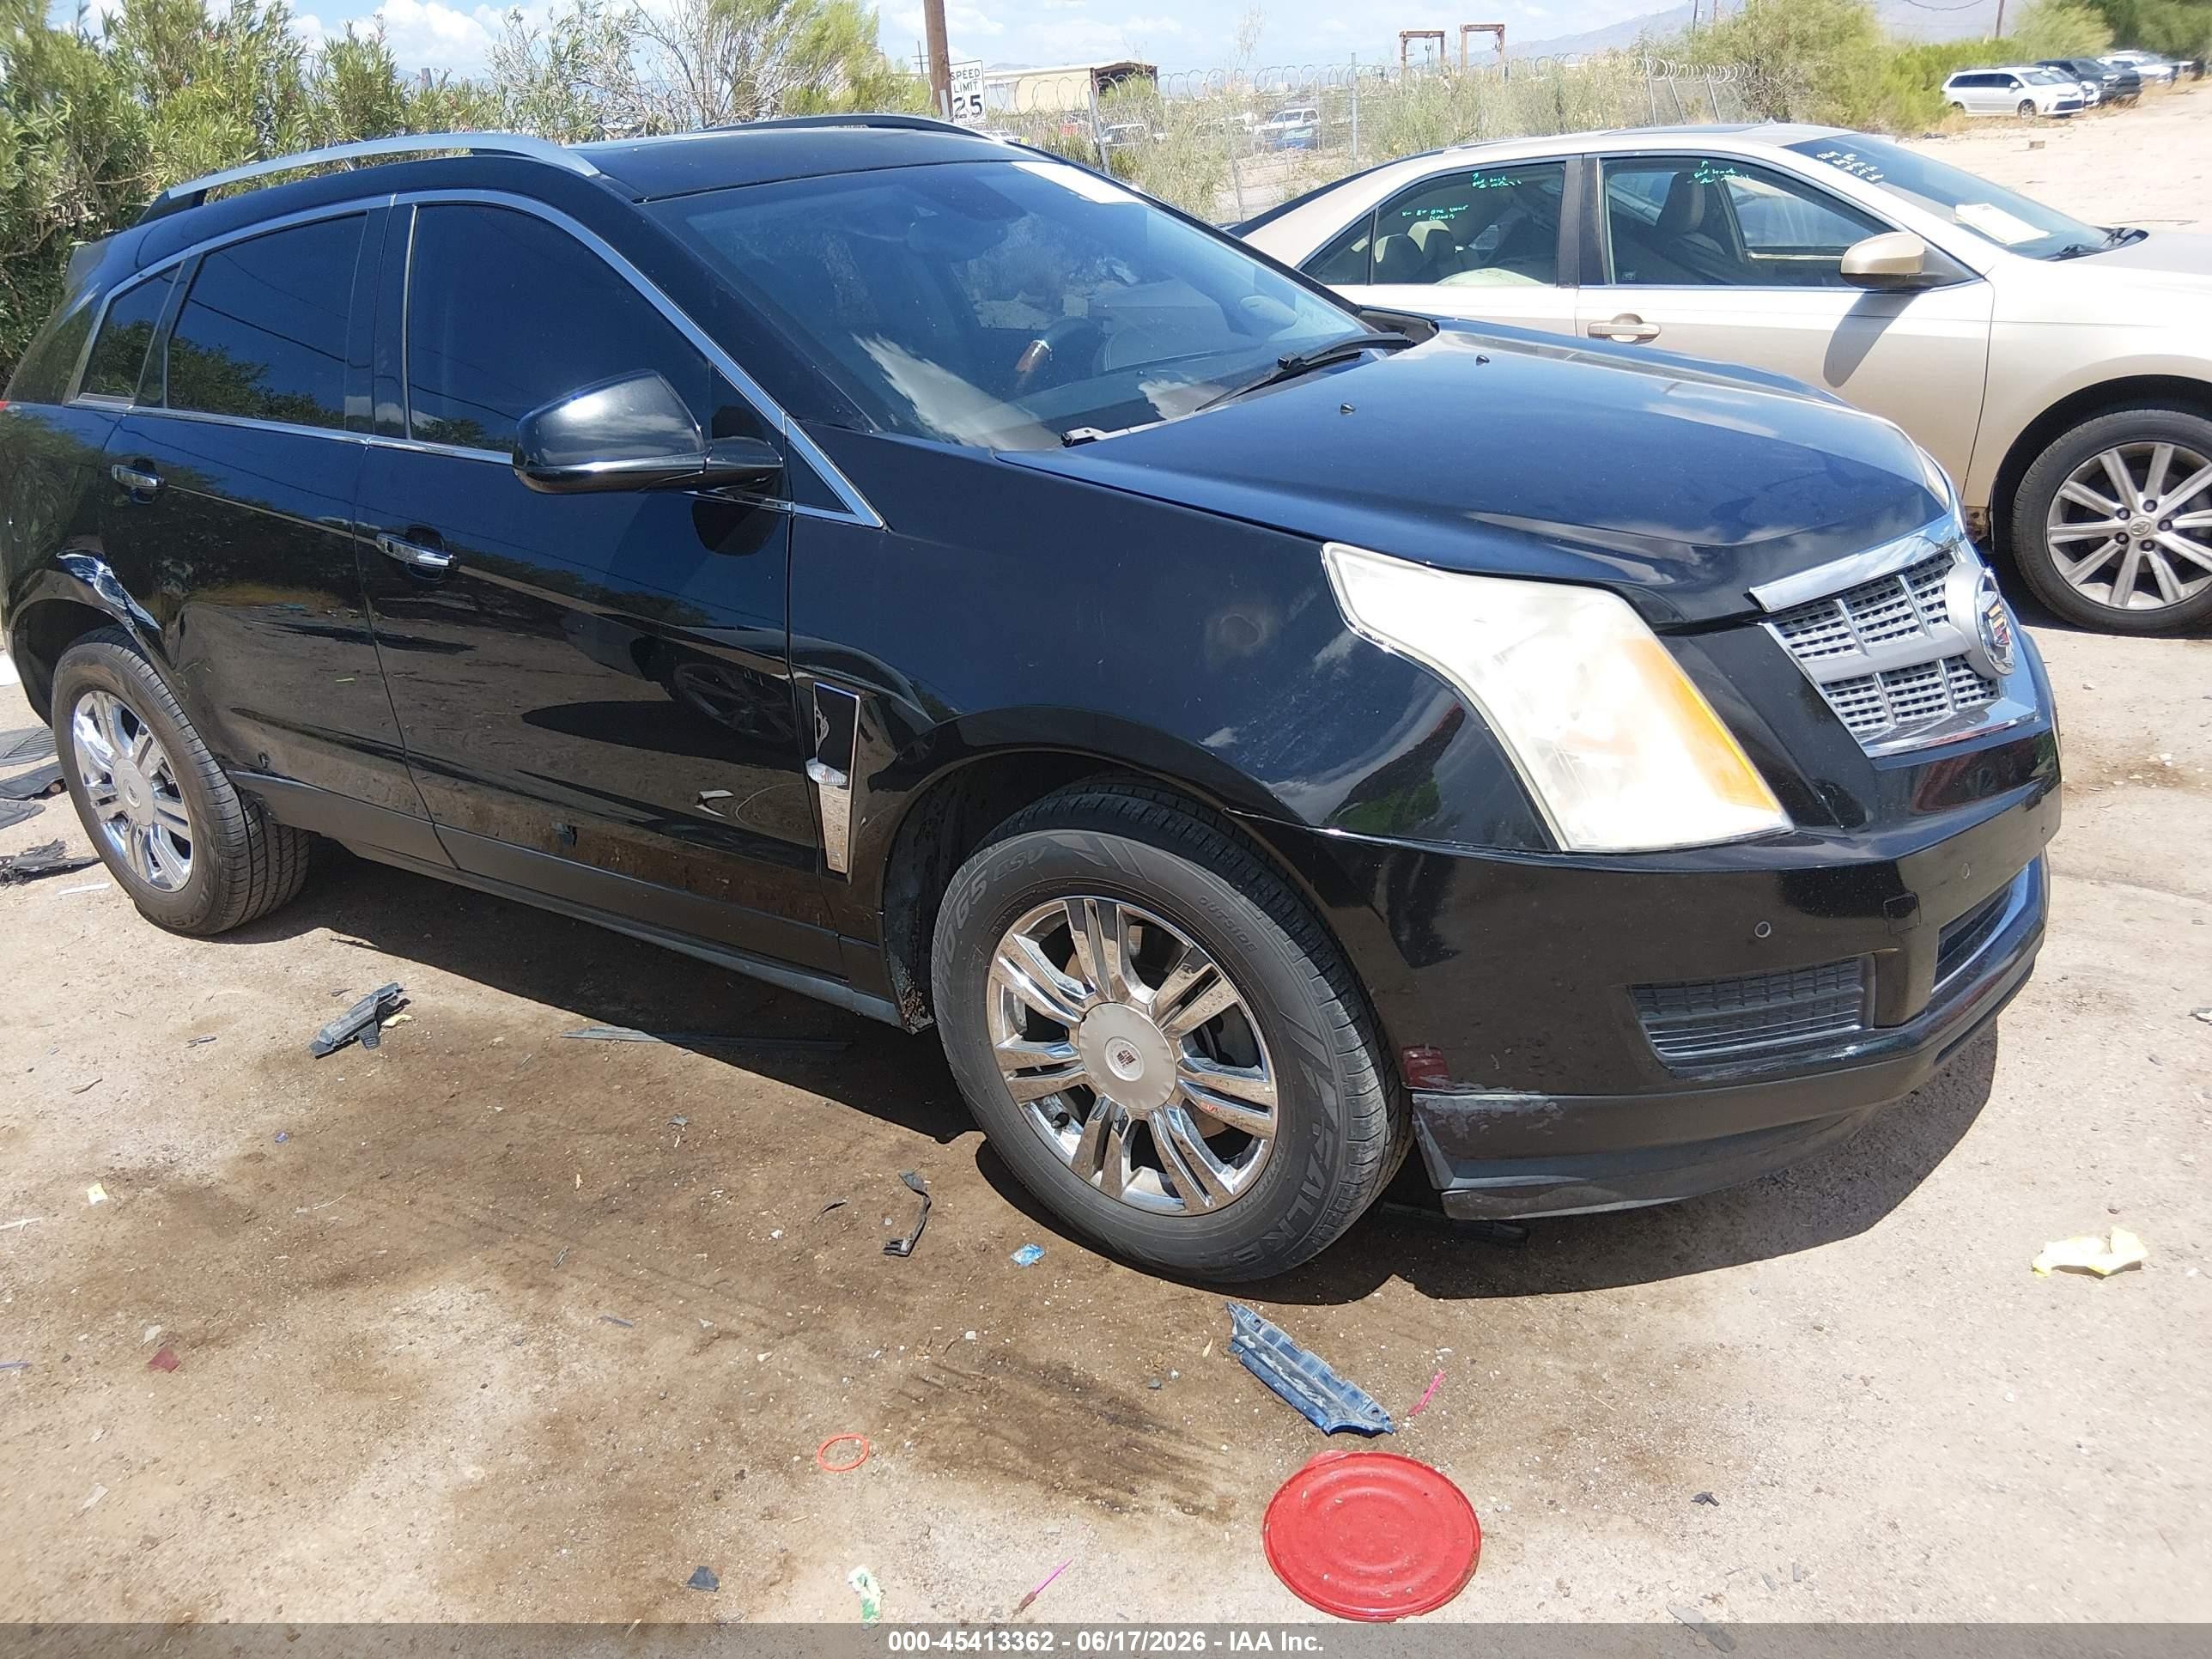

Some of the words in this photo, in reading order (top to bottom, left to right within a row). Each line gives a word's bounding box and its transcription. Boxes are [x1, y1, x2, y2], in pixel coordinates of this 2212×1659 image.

[949, 68, 981, 82] SPEED
[953, 81, 979, 94] LIMIT
[953, 94, 982, 118] 25
[1200, 895, 1258, 952] OUTSIDE
[1200, 1117, 1334, 1269] FALKE
